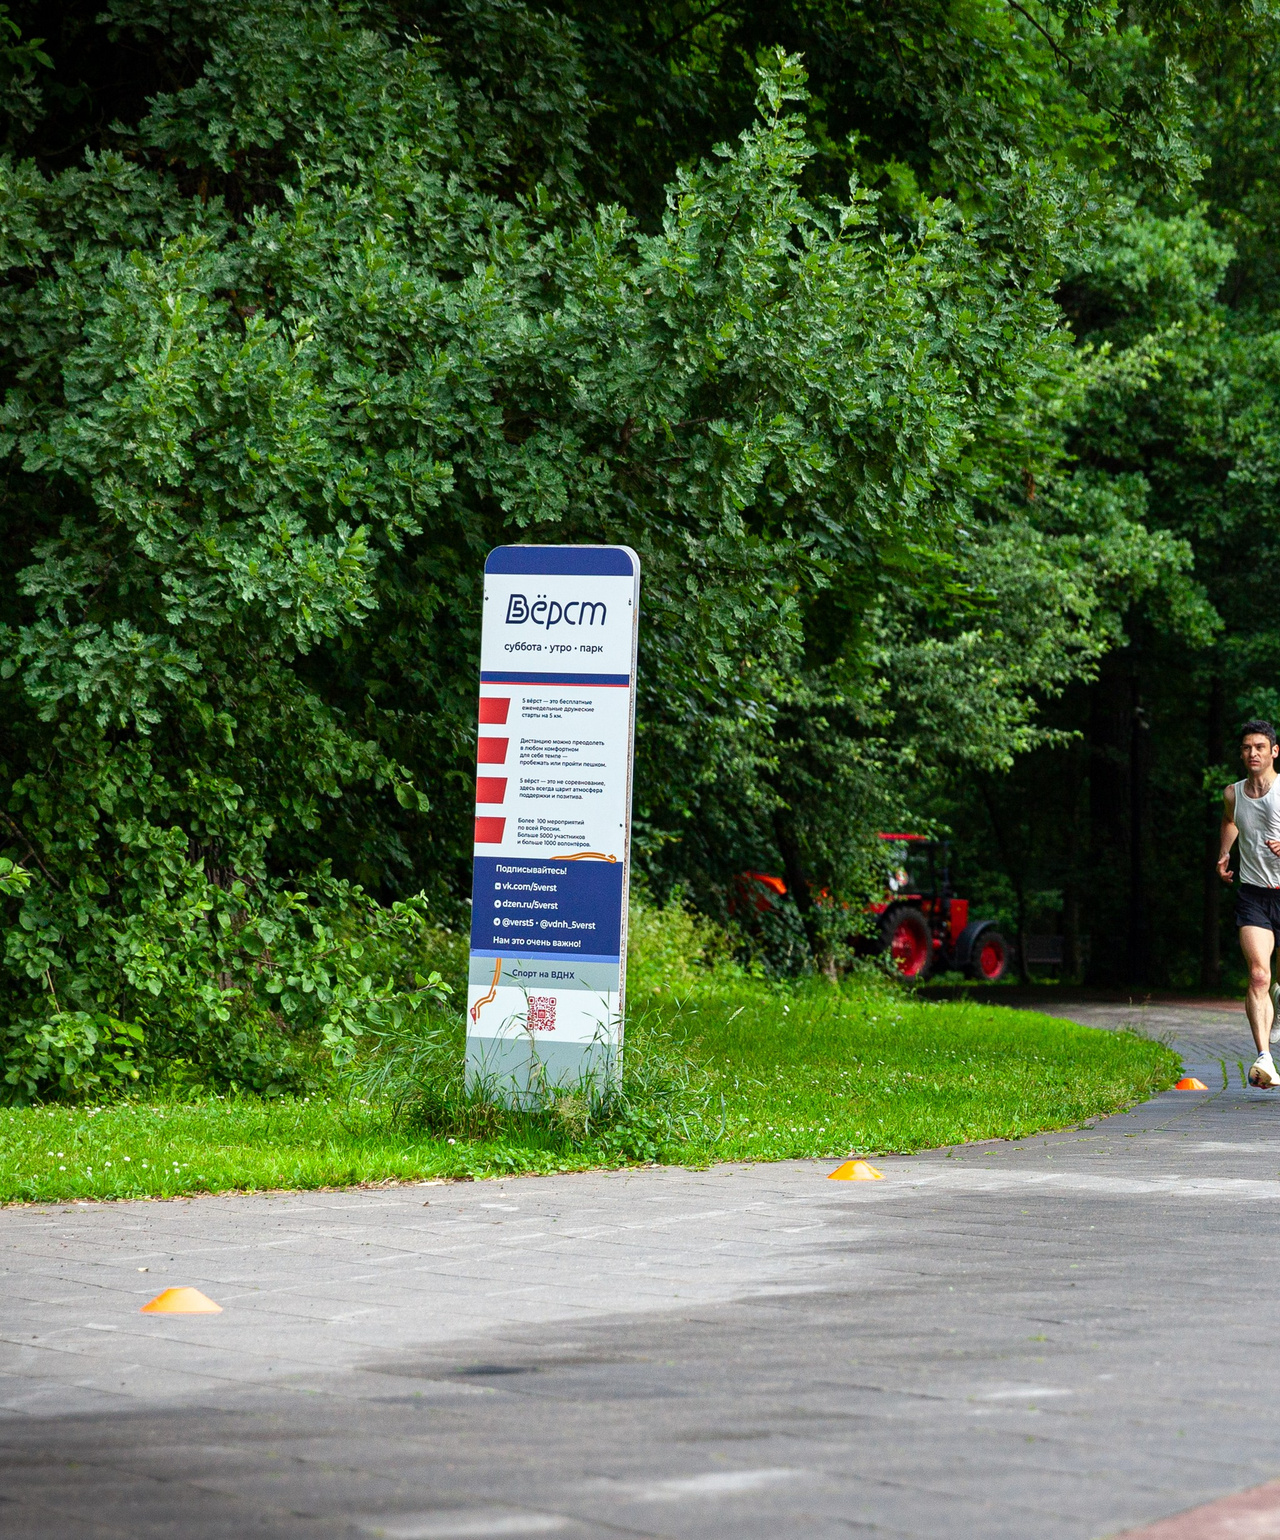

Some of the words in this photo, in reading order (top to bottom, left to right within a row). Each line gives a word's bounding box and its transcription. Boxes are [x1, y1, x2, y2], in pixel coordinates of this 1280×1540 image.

[504, 642, 542, 653] суббота
[550, 643, 572, 653] утро
[580, 644, 603, 654] парк
[547, 818, 584, 826] мероприятий
[496, 864, 567, 875] Подписывайтесь!
[502, 882, 557, 892] vk.com/5verst
[502, 900, 558, 910] dzen.ru/5verst
[502, 918, 534, 928] @verst5
[540, 920, 596, 930] @vdnh_5verst
[493, 936, 510, 944] Нам
[553, 940, 581, 948] важно!
[512, 969, 537, 979] Спорт
[551, 971, 575, 979] ВДНХ
